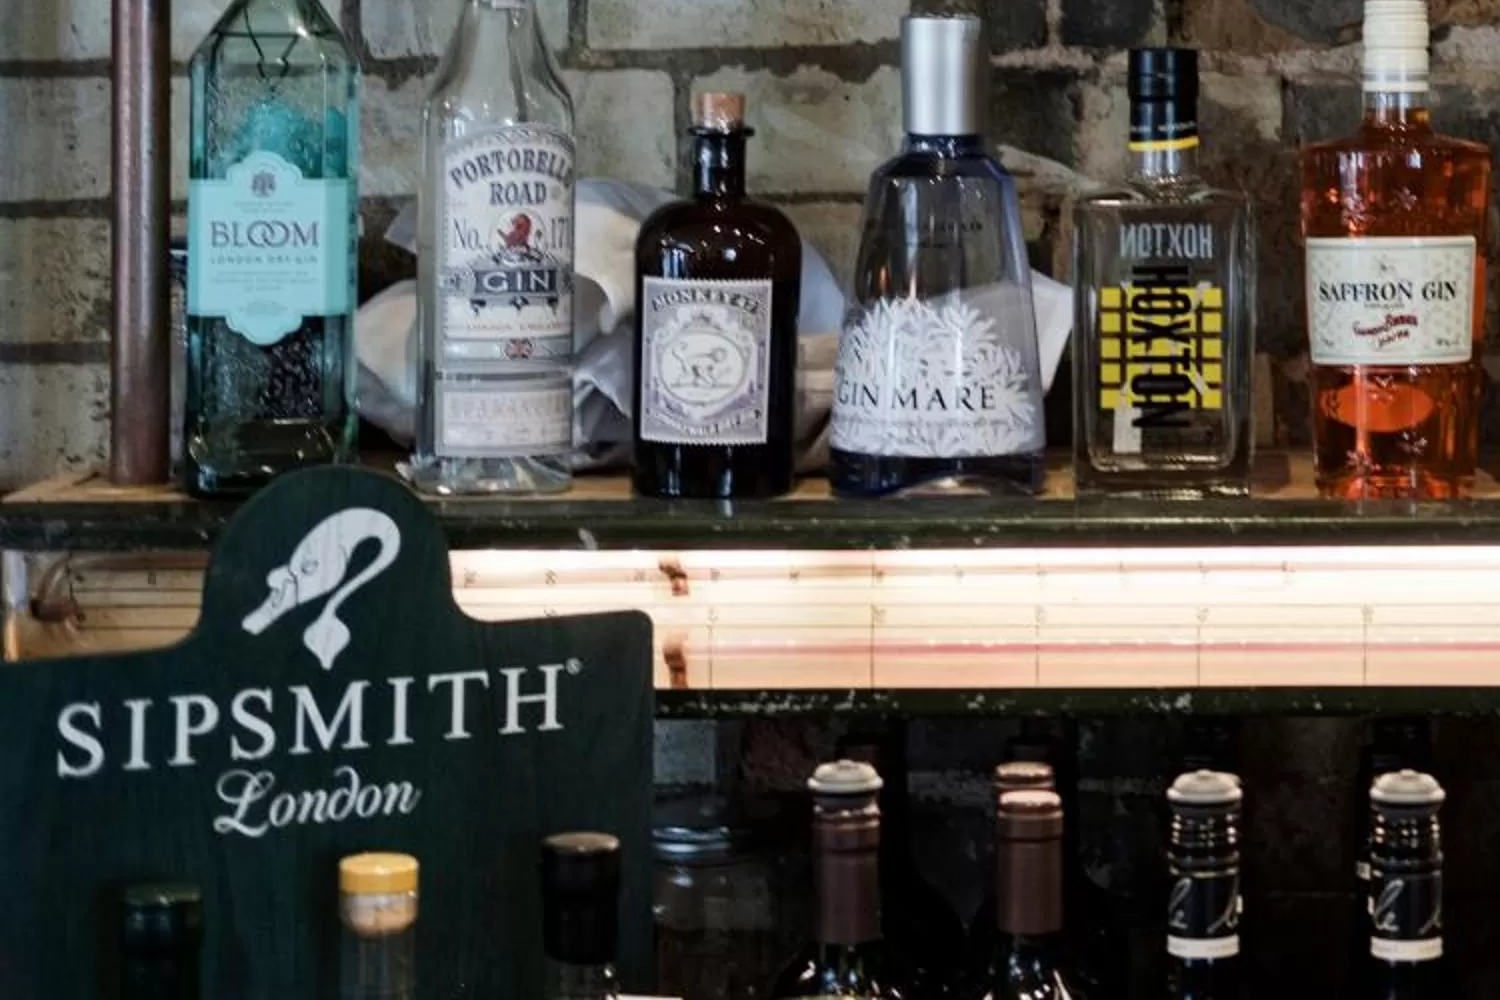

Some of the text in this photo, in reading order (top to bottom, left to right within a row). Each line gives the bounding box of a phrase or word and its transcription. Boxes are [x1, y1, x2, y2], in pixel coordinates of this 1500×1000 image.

[489, 181, 548, 207] ROAD
[210, 220, 320, 249] BLOOM
[481, 271, 550, 292] GIN
[1318, 280, 1457, 302] SAFFRON GIN
[1131, 265, 1192, 428] HOXTON
[837, 381, 997, 412] GIN MARE
[213, 765, 422, 838] London
